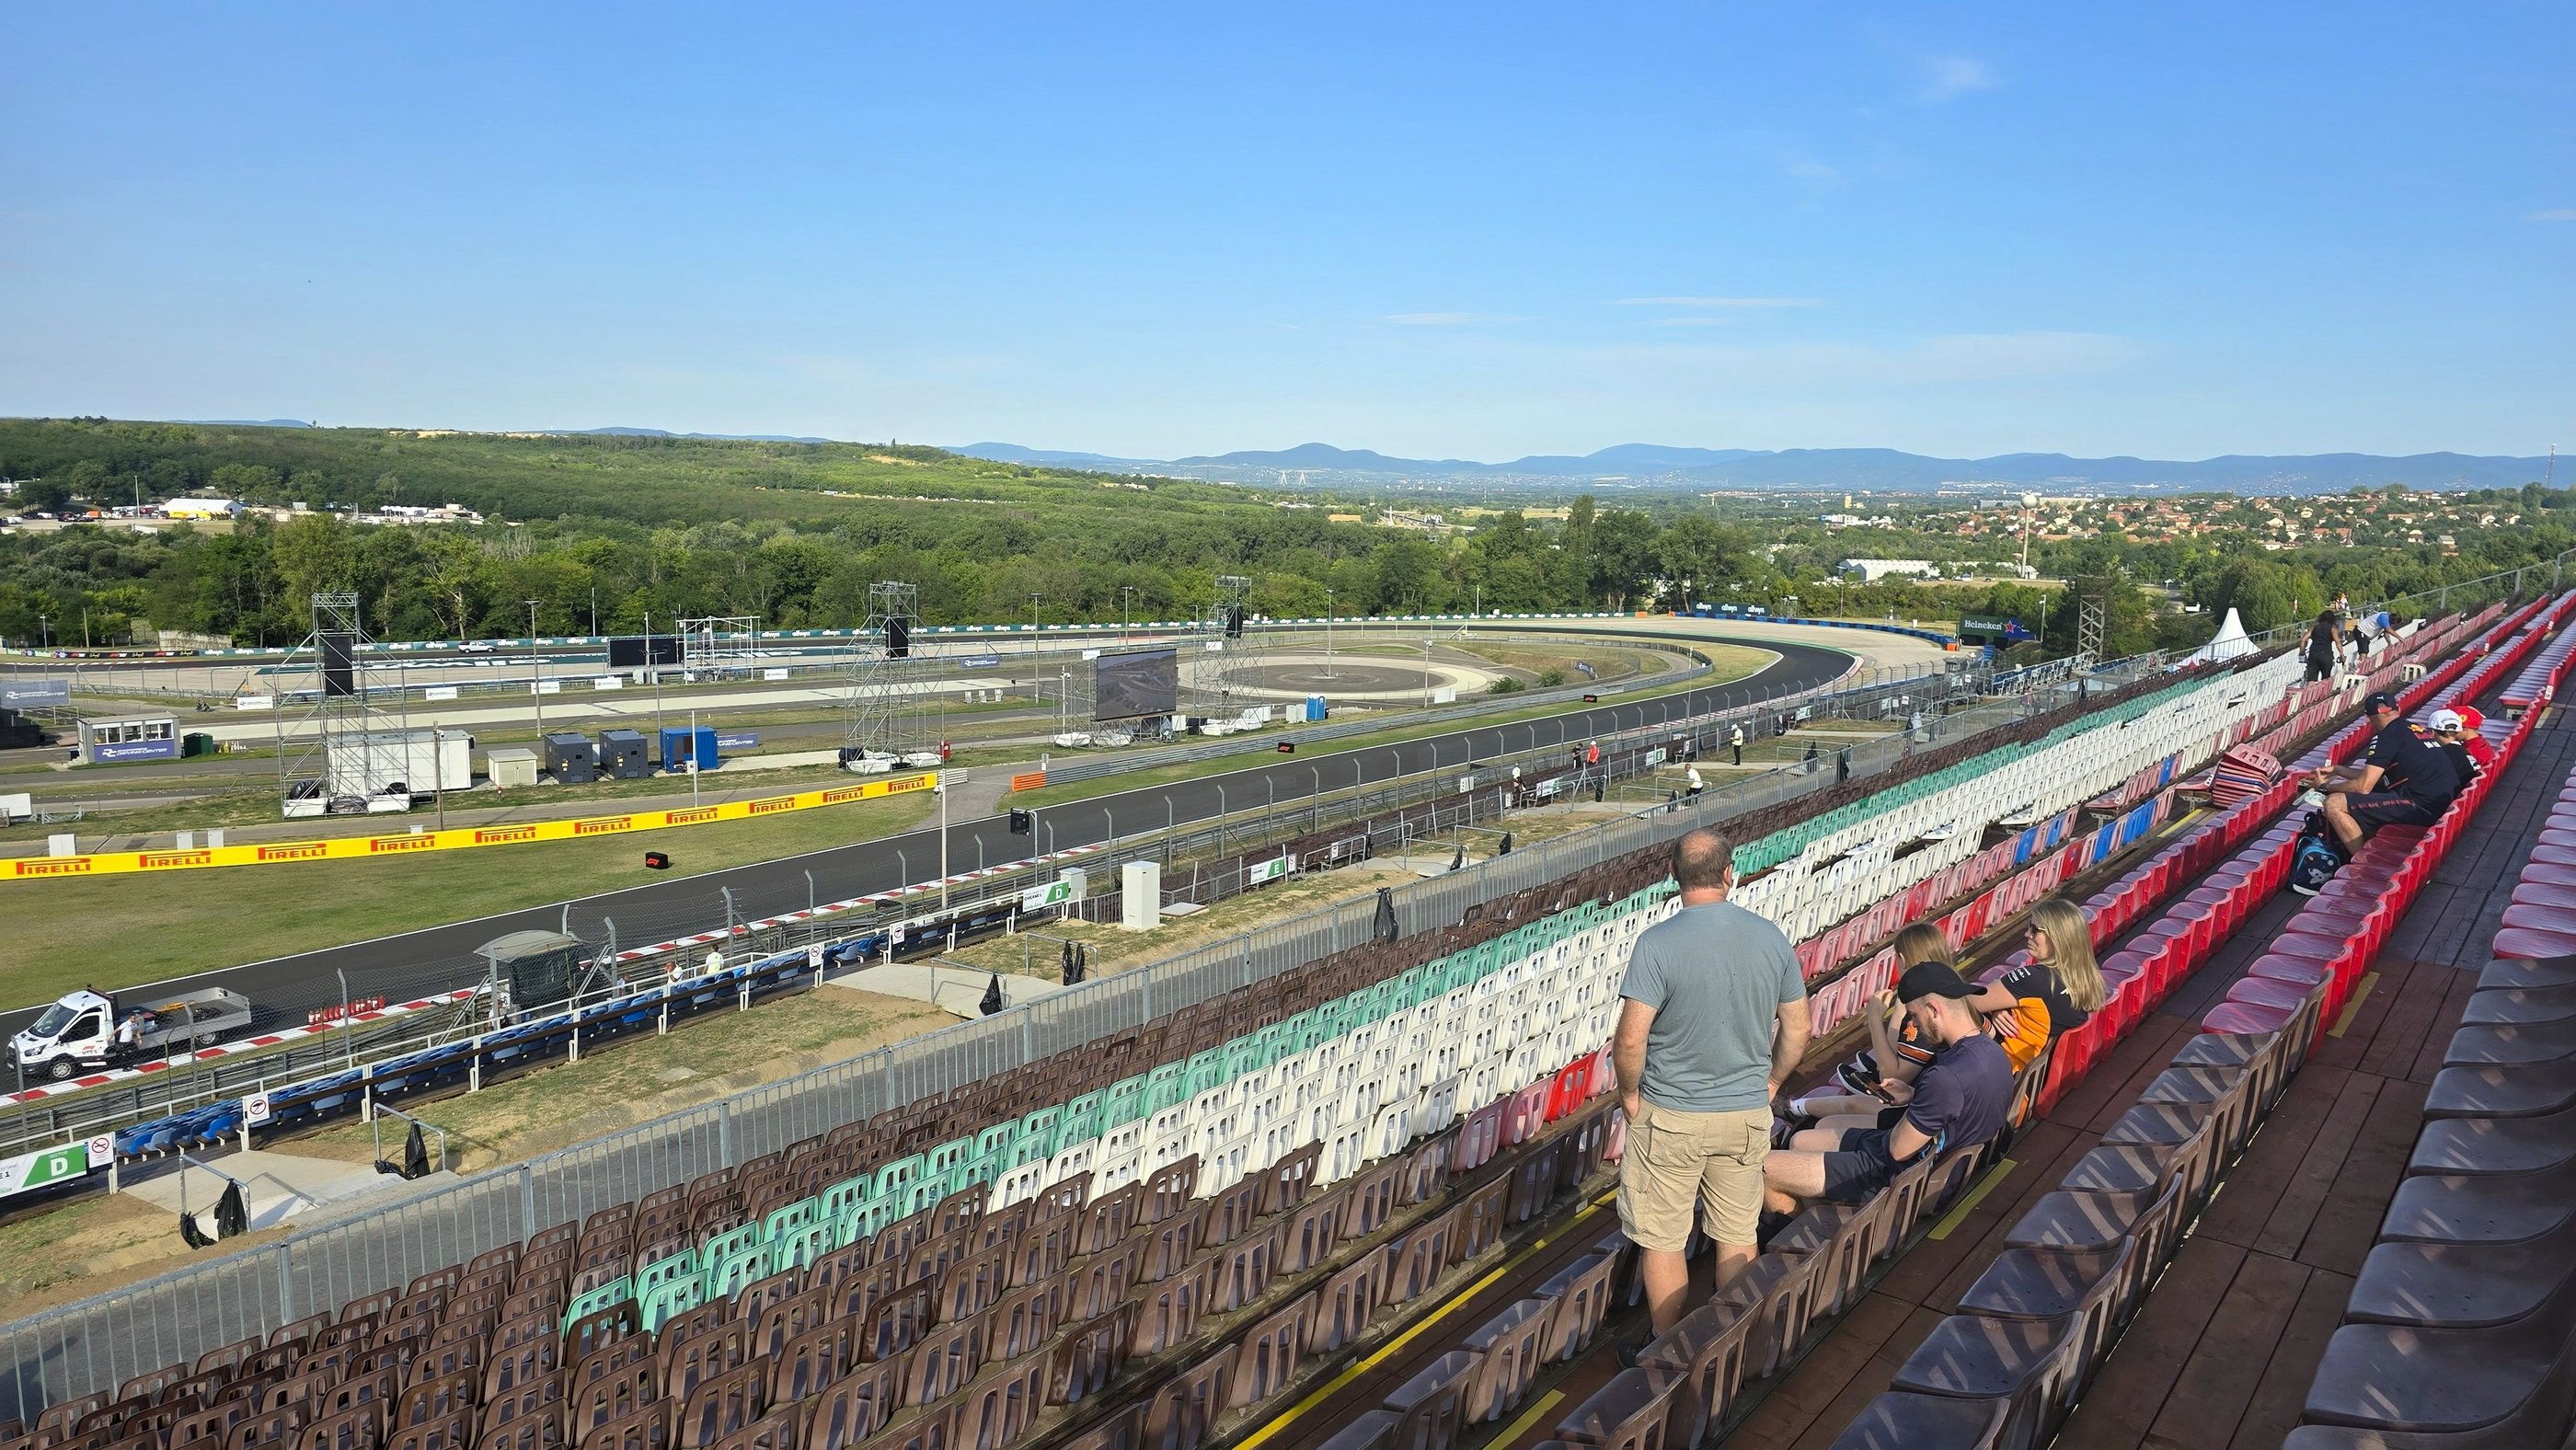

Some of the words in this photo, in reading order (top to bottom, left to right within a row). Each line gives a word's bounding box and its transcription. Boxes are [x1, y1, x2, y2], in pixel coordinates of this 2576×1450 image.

[1964, 619, 2002, 630] Heineken
[888, 777, 926, 793] PIRELLI
[822, 787, 864, 803] PIRELLI
[749, 797, 795, 814] PIRELLI
[666, 807, 718, 824] PIRELLI
[574, 817, 631, 834] PIRELLI
[370, 834, 435, 852] PIRELLI
[475, 826, 536, 844] PIRELLI
[139, 851, 212, 868] PIRELLI
[258, 843, 327, 860] PIRELLI
[16, 857, 91, 875] PIRELLI
[1055, 888, 1063, 900] D
[50, 1157, 68, 1177] D
